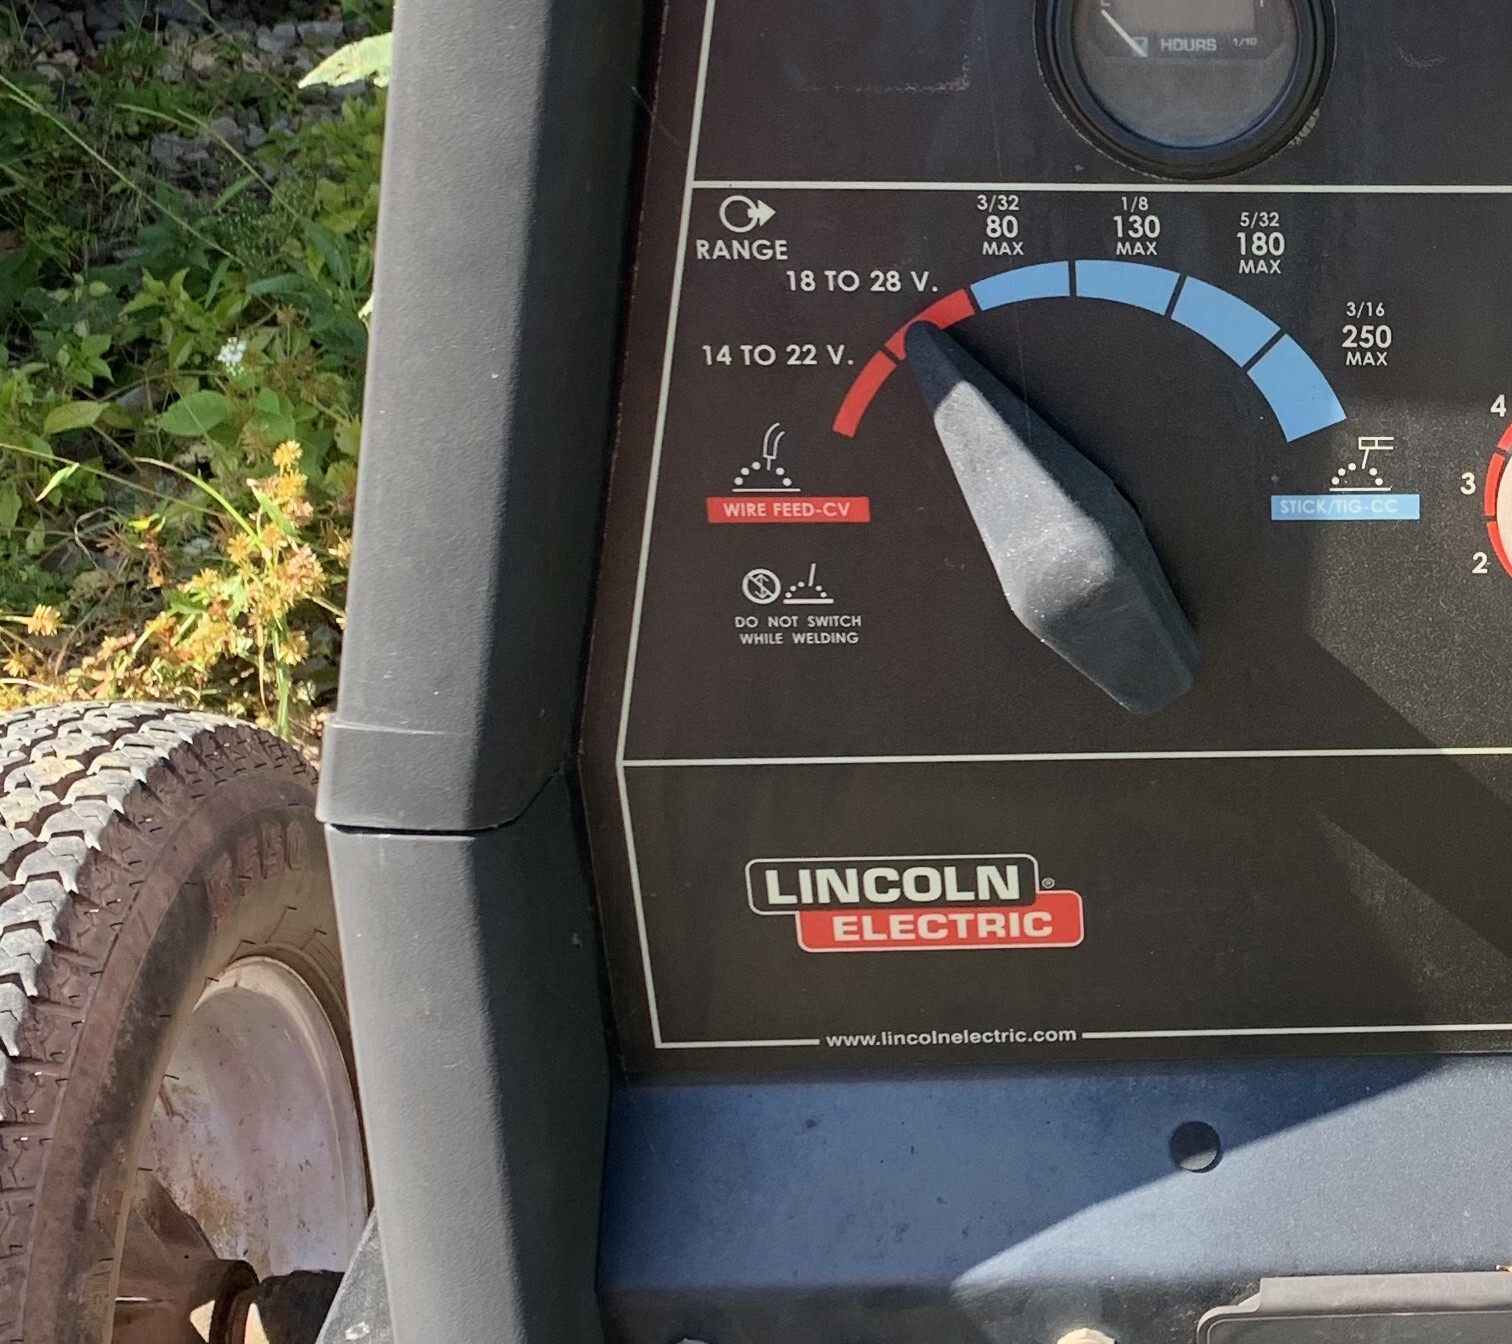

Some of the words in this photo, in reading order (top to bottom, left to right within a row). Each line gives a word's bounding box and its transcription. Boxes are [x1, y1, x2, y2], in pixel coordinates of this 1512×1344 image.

[1160, 38, 1217, 52] HOURS
[976, 195, 1020, 211] 3/32
[1121, 196, 1148, 213] 1/8
[986, 215, 1019, 239] 80
[1112, 214, 1161, 239] 130
[1240, 211, 1281, 228] 5/32
[696, 239, 788, 261] RANGE
[982, 241, 1025, 256] MAX
[1116, 241, 1158, 256] MAX
[1236, 231, 1285, 257] 180
[1238, 259, 1282, 275] MAX
[786, 270, 816, 292] 18
[824, 270, 860, 292] TO
[870, 270, 902, 292] 28
[910, 270, 938, 293] V.
[1346, 301, 1386, 318] 3/16
[1342, 325, 1392, 349] 250
[702, 344, 732, 366] 14
[740, 344, 776, 366] TO
[786, 344, 817, 366] 22
[827, 344, 854, 366] V.
[1345, 351, 1389, 367] MAX
[1490, 394, 1507, 417] 4
[1460, 472, 1477, 495] 3
[723, 502, 767, 517] WIRE
[773, 502, 851, 517] FEED-CV
[1280, 499, 1398, 515] STICK/TIG-CC
[1472, 552, 1488, 575] 2
[735, 616, 759, 628] DO
[768, 616, 798, 628] NOT
[807, 615, 862, 628] SWITCH
[739, 632, 784, 645] WHILE
[792, 632, 859, 645] WELDING
[765, 865, 1021, 905] LINCOLN
[832, 912, 1053, 943] ELECTRIC
[826, 1029, 1077, 1048] www.lincolnelectric.com
